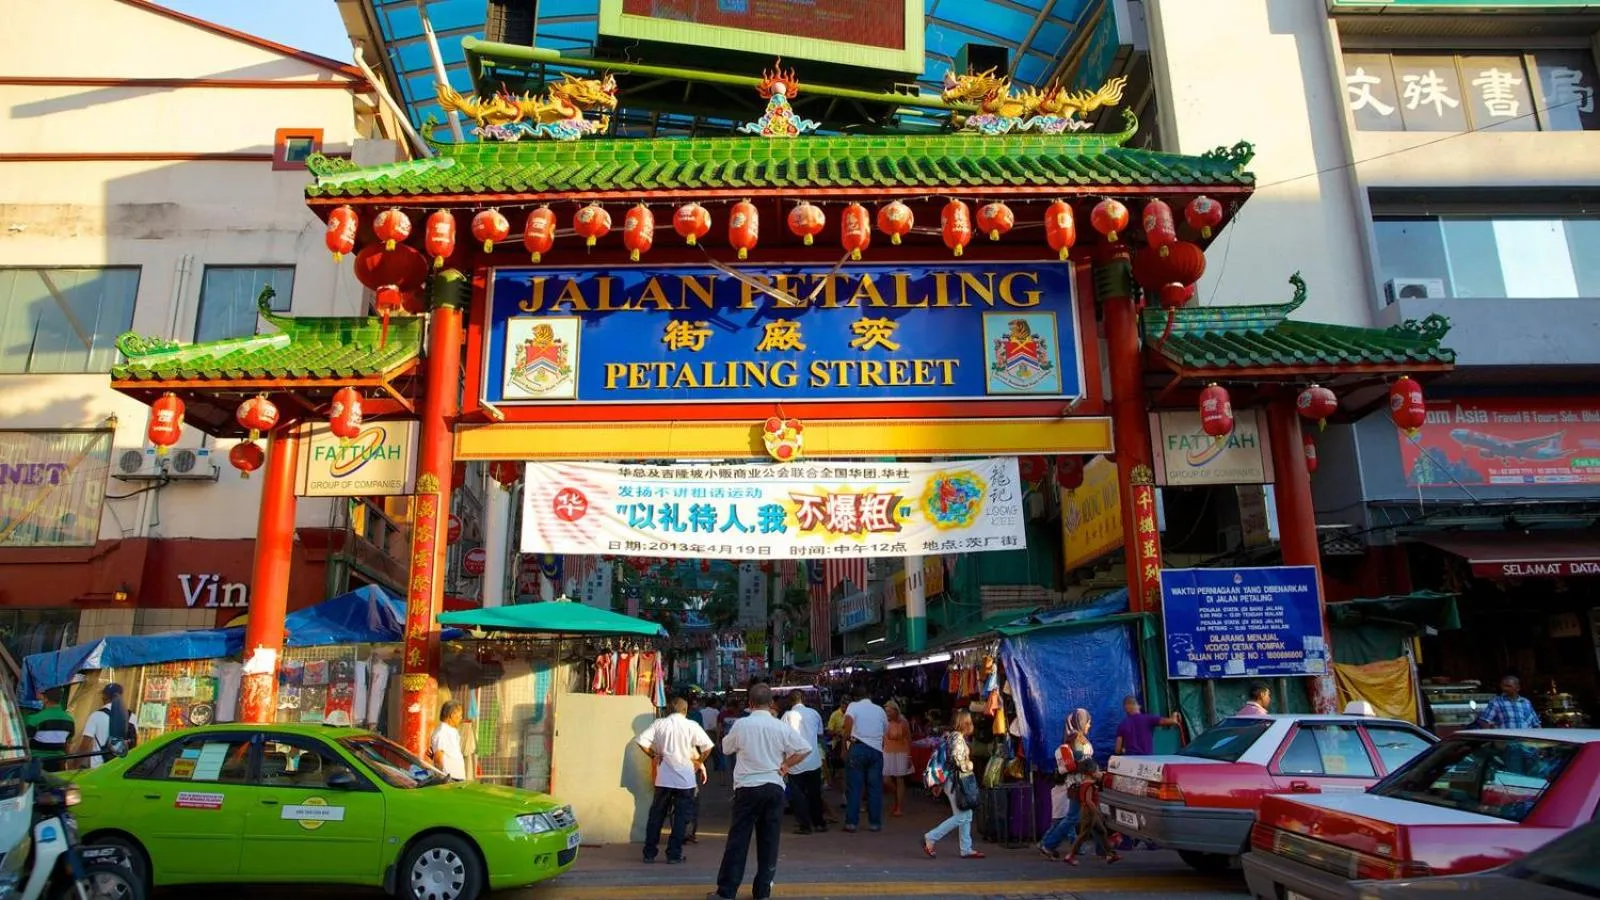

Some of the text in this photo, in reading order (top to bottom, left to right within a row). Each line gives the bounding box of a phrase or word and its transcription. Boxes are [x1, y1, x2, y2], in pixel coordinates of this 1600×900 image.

[519, 271, 1045, 311] JALAN PETALING
[603, 360, 799, 391] PETALING
[809, 358, 960, 389] STREET
[1455, 404, 1488, 423] Asia
[1493, 411, 1521, 423] Travel
[1167, 432, 1255, 450] FATTAH
[314, 444, 401, 461] FATTUAH
[311, 480, 401, 490] GROUP OF COMPANIES
[1502, 563, 1562, 575] SELAMAT
[1171, 587, 1196, 596] WAKTU
[1243, 585, 1261, 594] YANG
[1216, 595, 1238, 603] JALAN
[1240, 594, 1273, 603] PETALING
[1210, 634, 1244, 643] DILARANG
[1215, 652, 1228, 660] HOT
[1231, 651, 1245, 660] LINE
